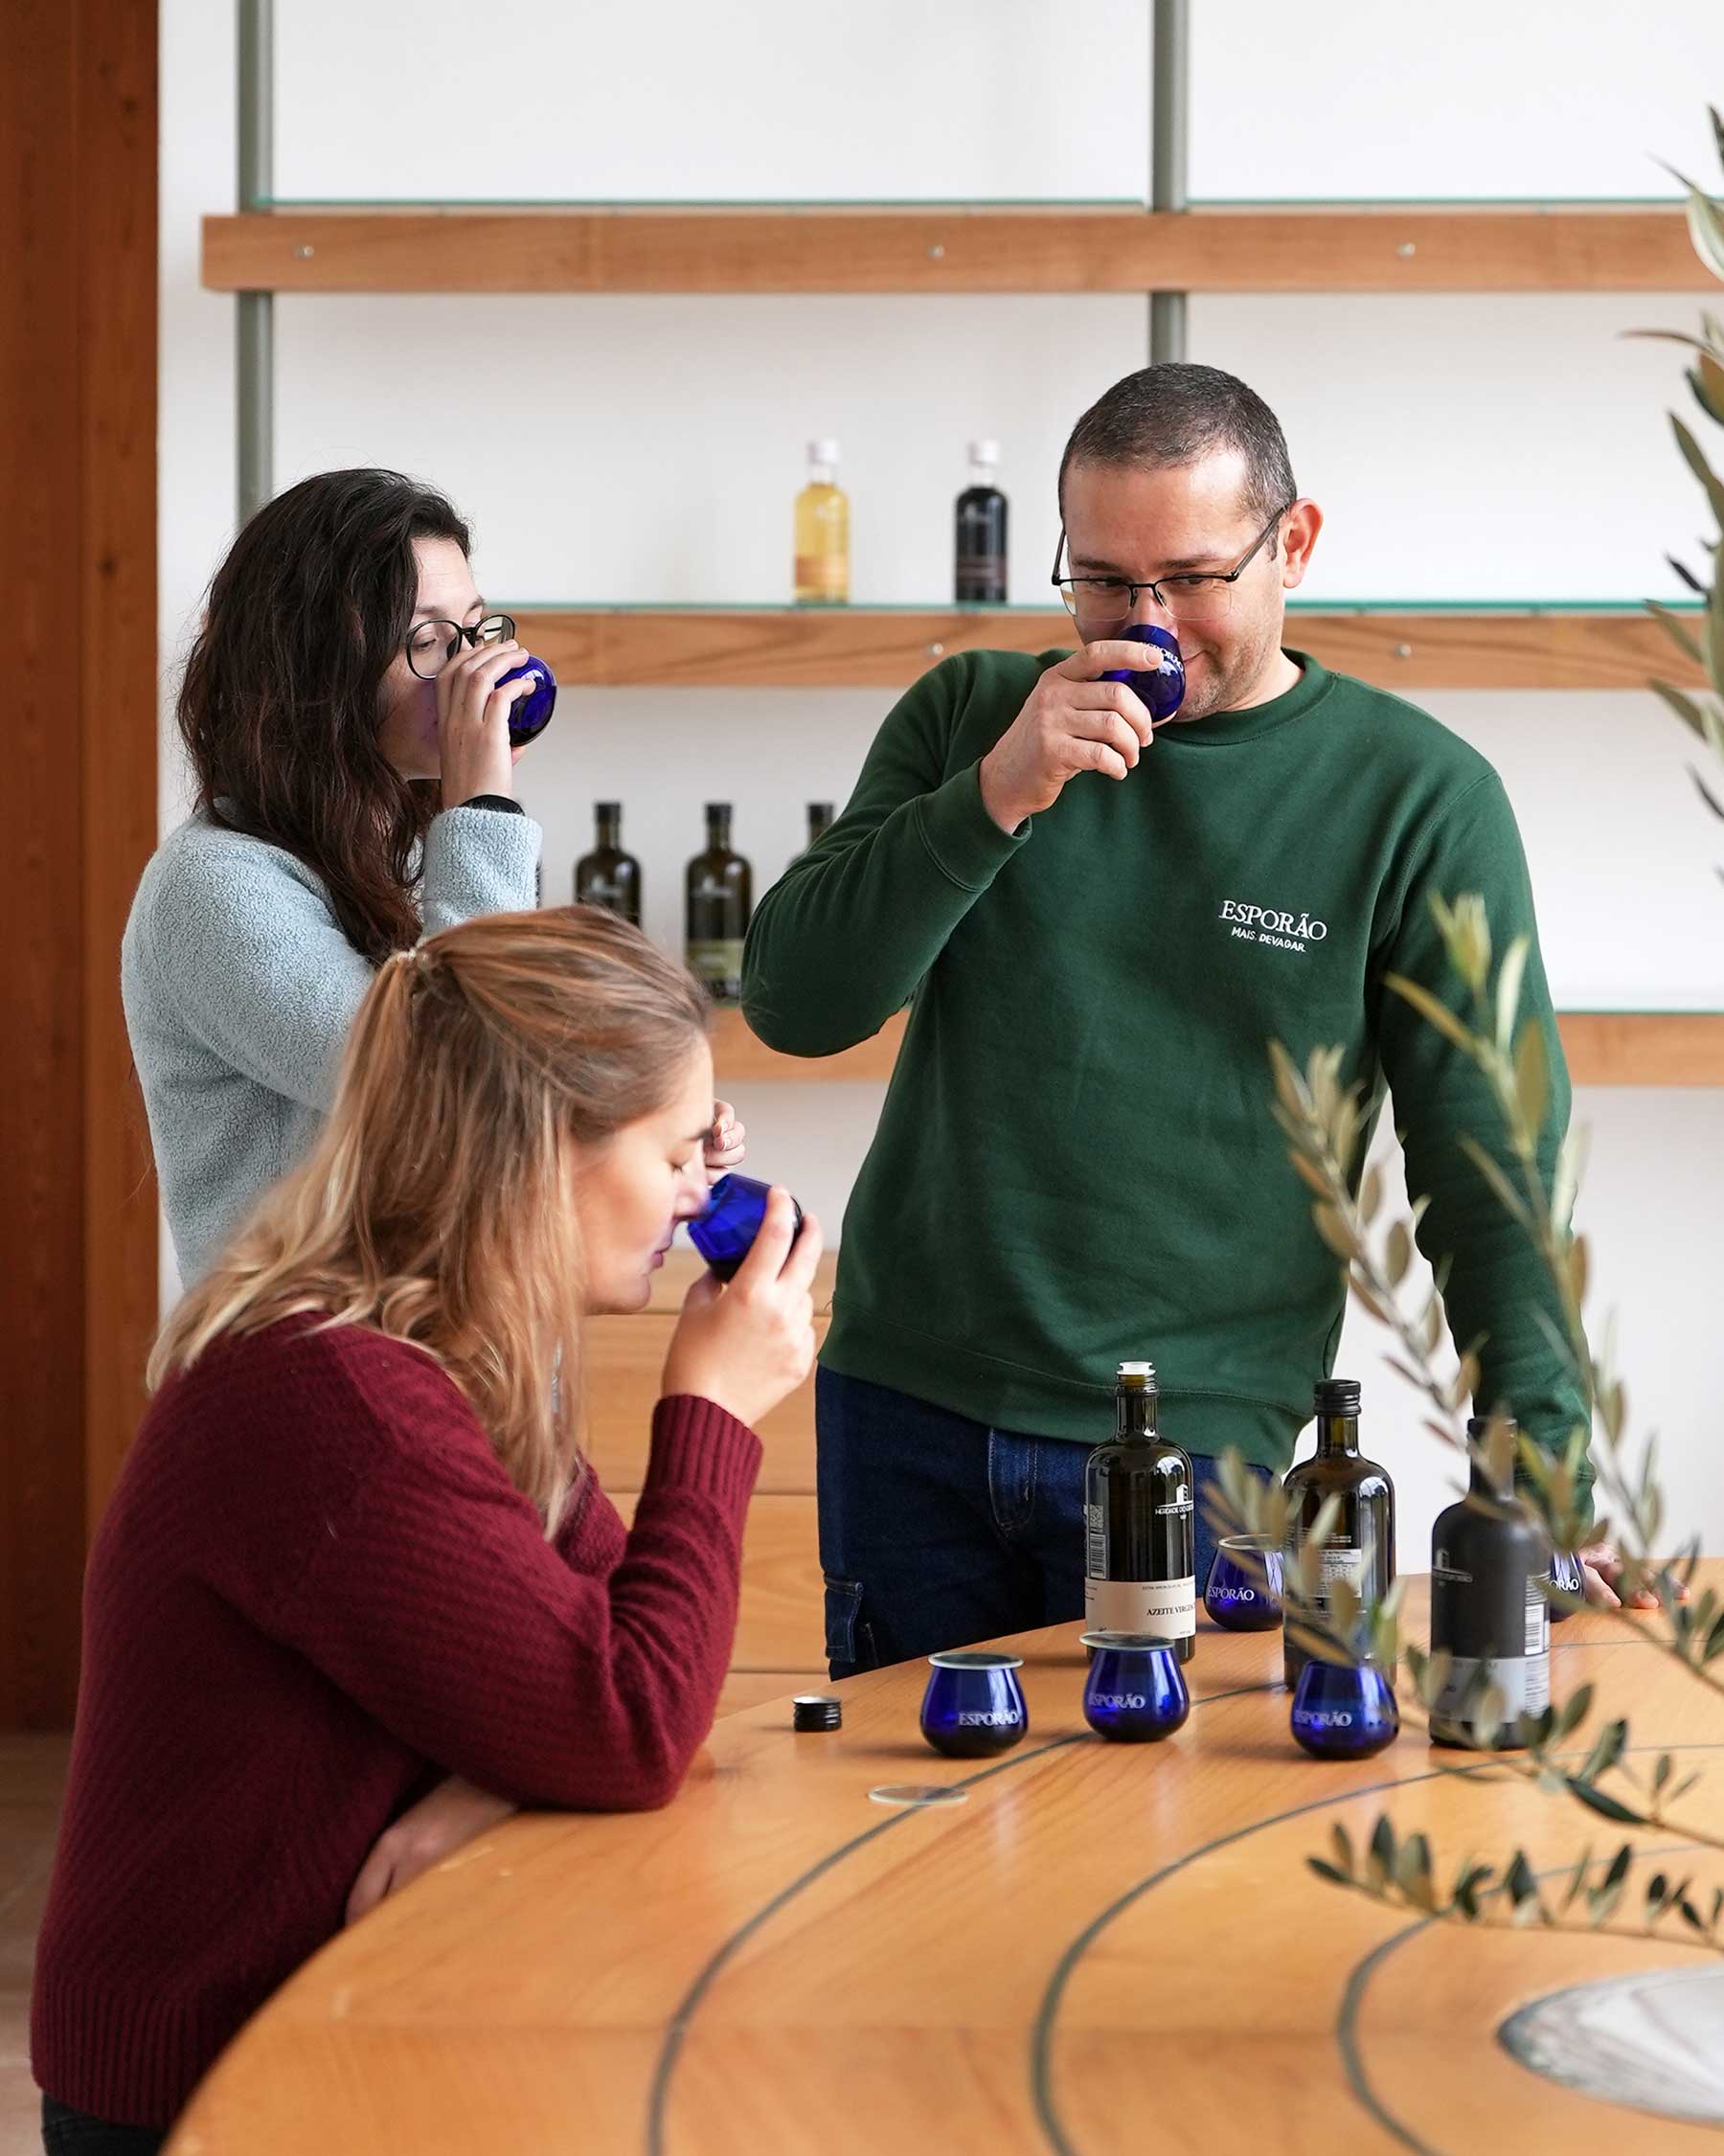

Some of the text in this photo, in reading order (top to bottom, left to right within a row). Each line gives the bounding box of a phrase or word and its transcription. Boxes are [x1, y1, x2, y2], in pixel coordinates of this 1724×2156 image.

[1218, 899, 1327, 941] ESPORÃO
[1259, 933, 1306, 952] DEVAGAR
[1207, 1585, 1255, 1601] ESPORÃO
[1146, 1607, 1174, 1617] AZEITE
[1088, 1692, 1146, 1710] ESPORÃO
[958, 1709, 1019, 1727] ESPORÃO
